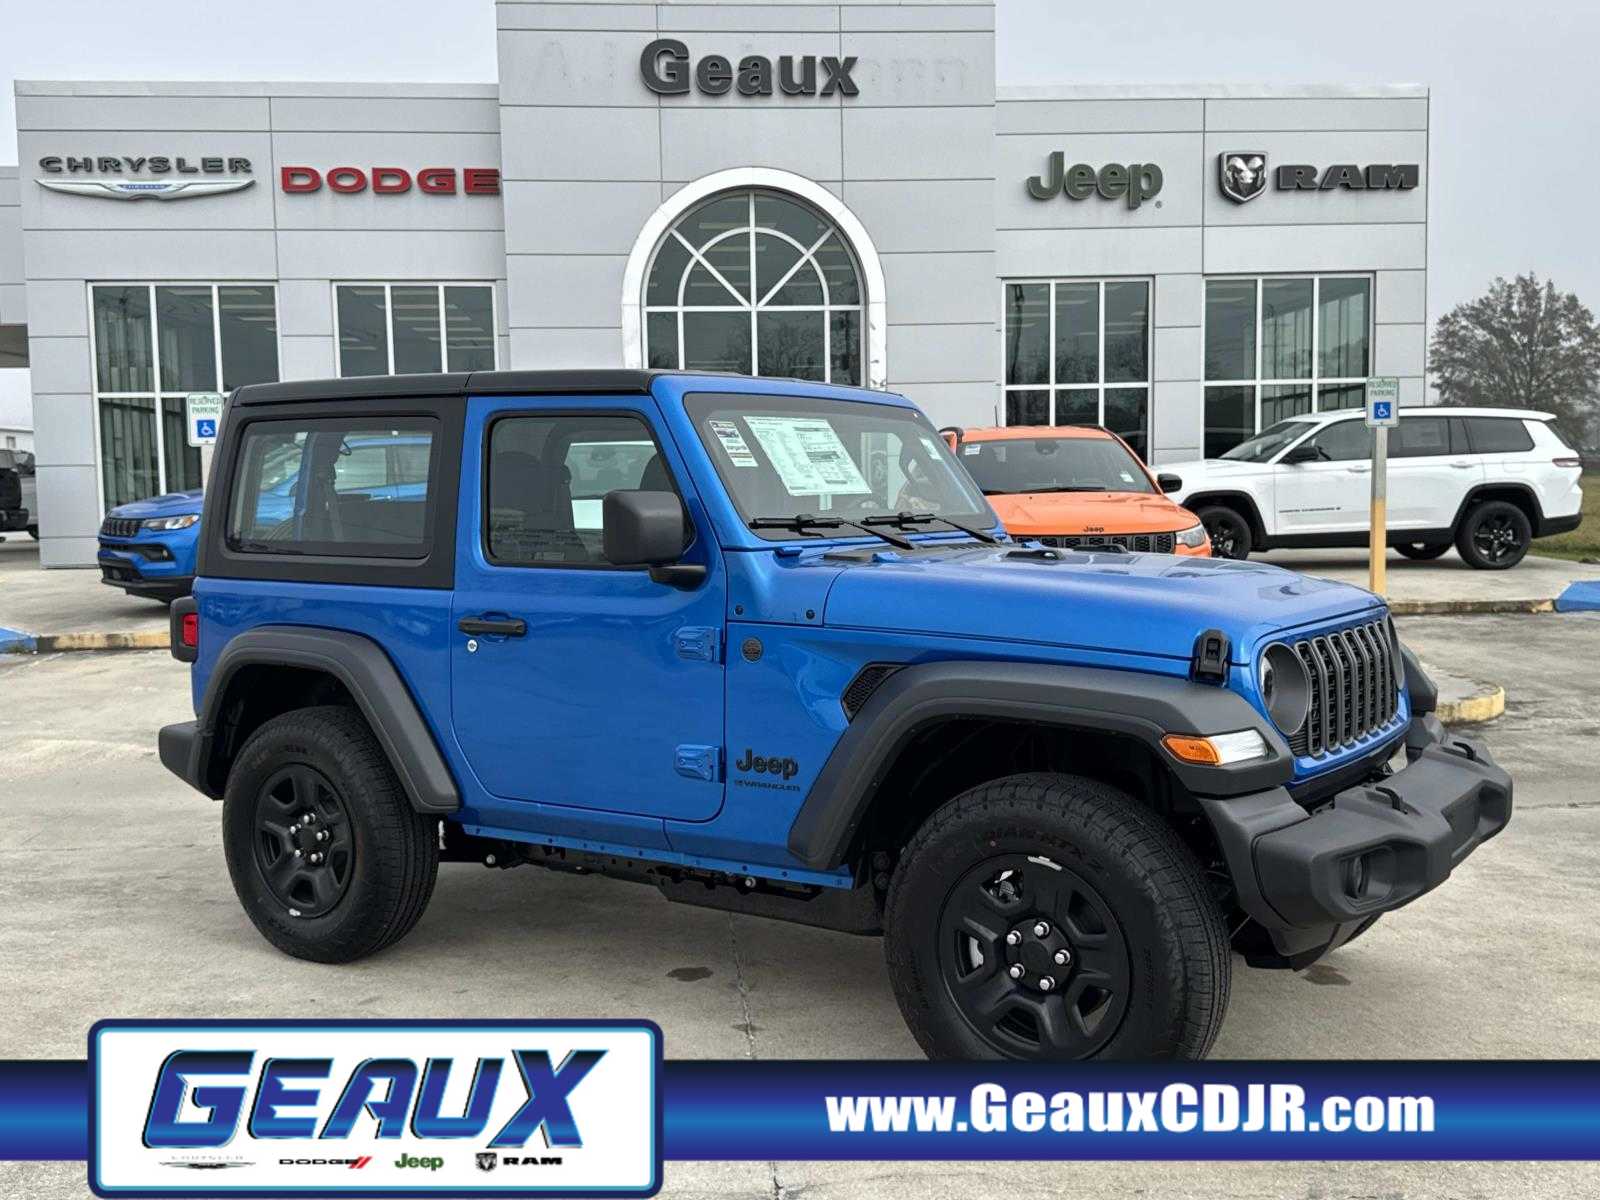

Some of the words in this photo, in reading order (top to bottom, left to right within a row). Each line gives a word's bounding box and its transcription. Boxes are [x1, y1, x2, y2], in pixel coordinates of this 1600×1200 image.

[640, 38, 860, 97] Geaux
[39, 156, 253, 174] CHRYSLER
[1028, 151, 1163, 209] Jeep
[1277, 164, 1420, 192] RAM
[281, 166, 500, 196] DODGE
[1083, 525, 1105, 533] Jeep
[735, 747, 799, 781] Jeep
